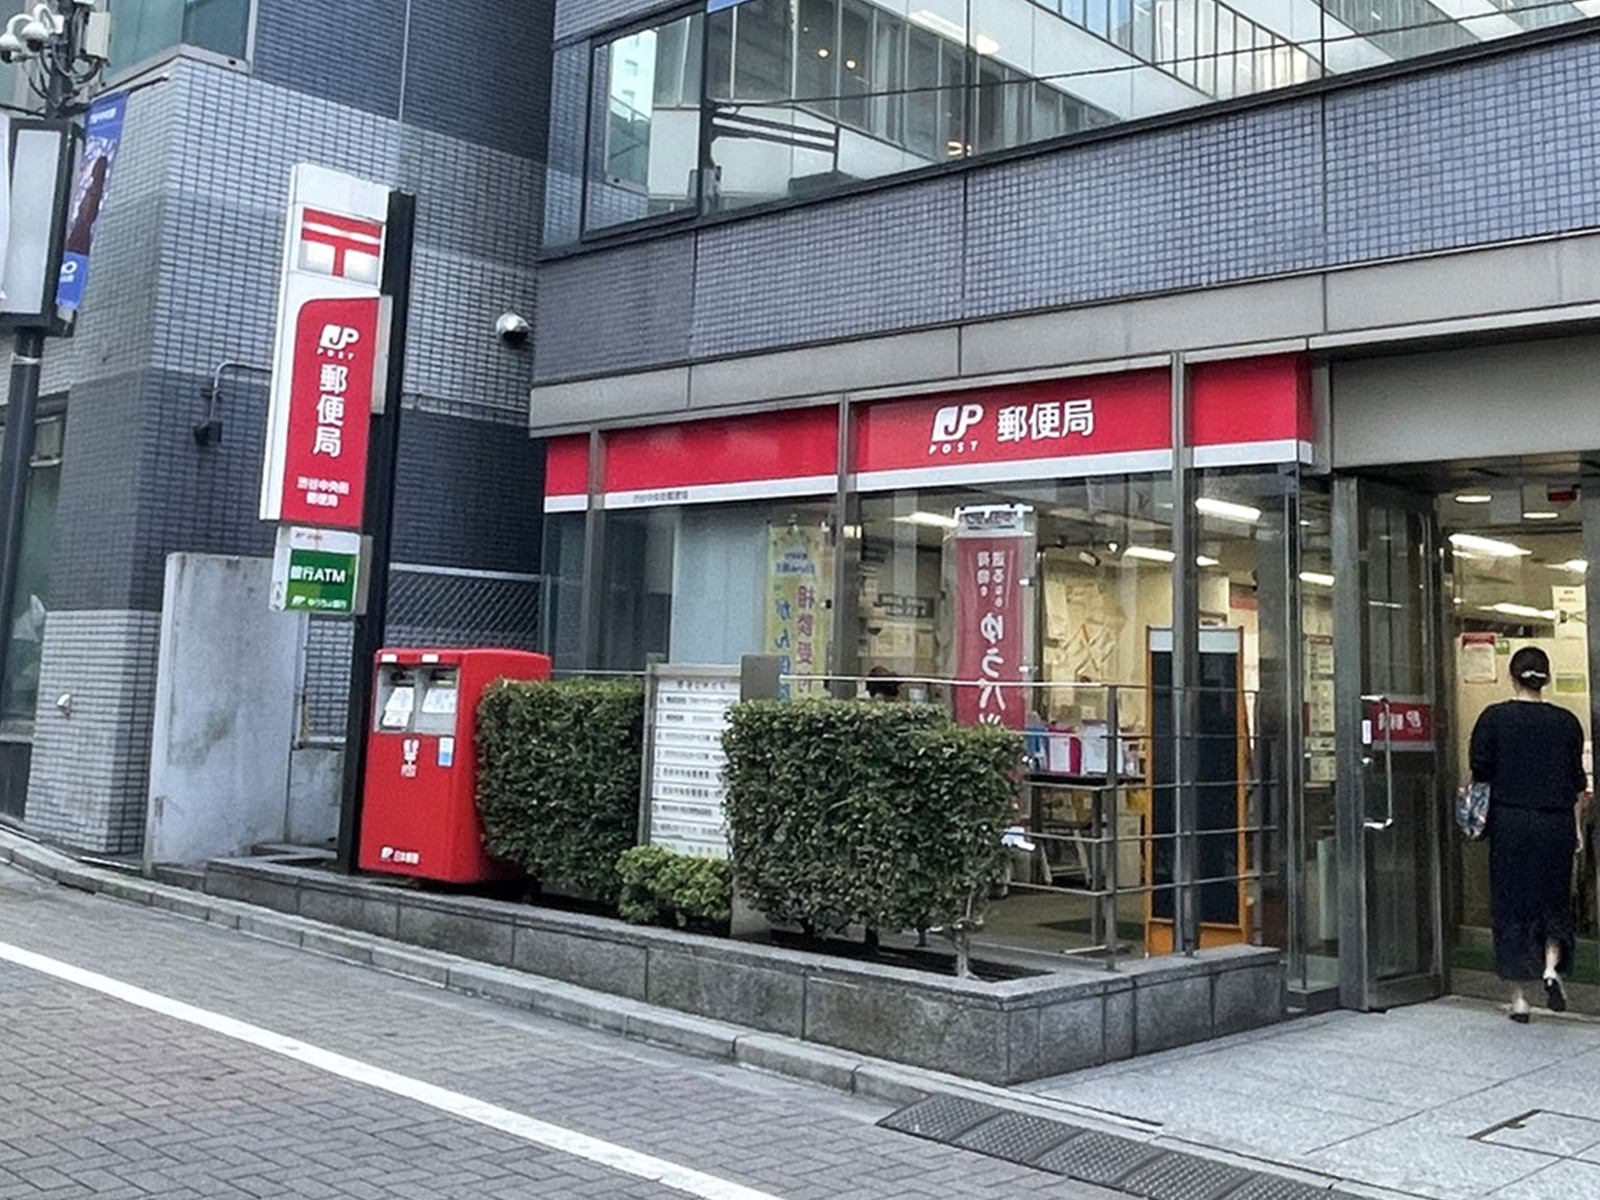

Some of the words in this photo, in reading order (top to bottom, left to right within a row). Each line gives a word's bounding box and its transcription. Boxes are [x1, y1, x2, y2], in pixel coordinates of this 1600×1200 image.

[320, 324, 359, 350] JP
[313, 363, 348, 457] 郵便局
[931, 404, 984, 442] JP
[997, 399, 1094, 442] 郵便局
[928, 441, 978, 455] POST
